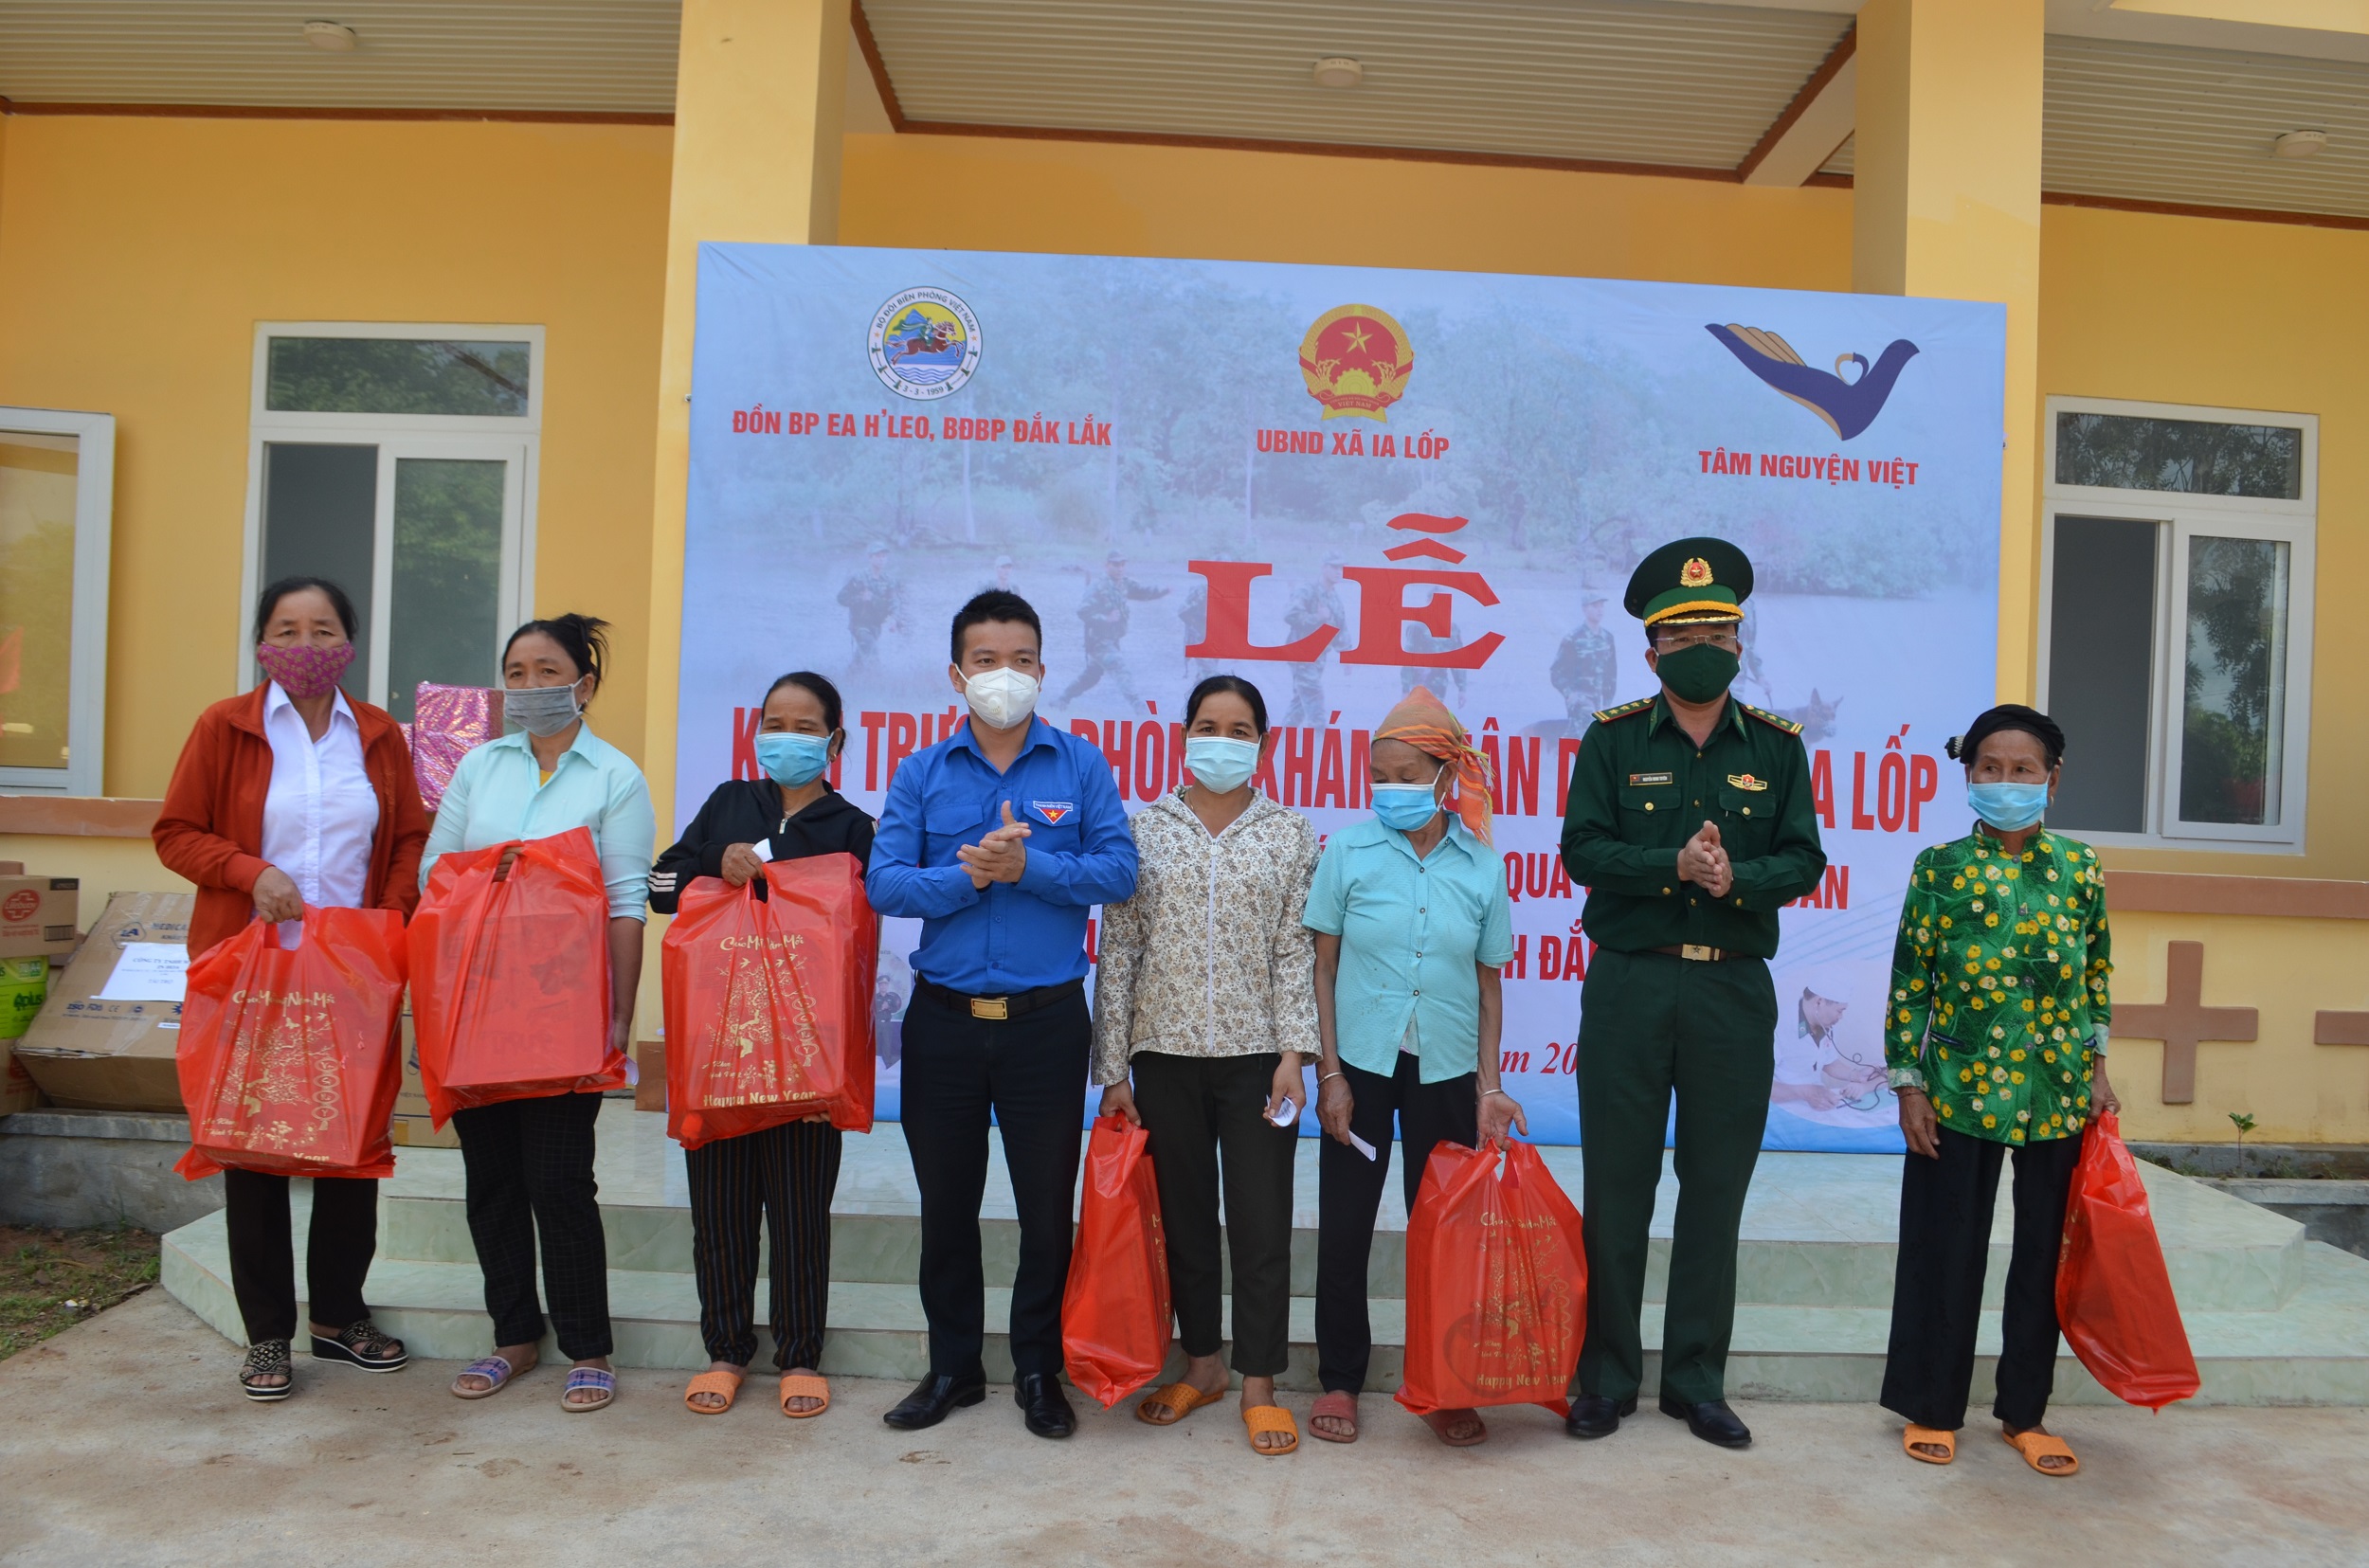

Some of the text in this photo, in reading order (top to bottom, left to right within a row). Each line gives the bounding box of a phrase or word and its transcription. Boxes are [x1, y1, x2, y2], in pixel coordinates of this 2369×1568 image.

[876, 290, 976, 333] BỘ ĐỘI BIÊN PHÒNG VIỆT NAM
[927, 386, 944, 396] 1959
[732, 404, 781, 435] ĐỒN
[788, 411, 820, 435] BP
[827, 413, 857, 437] EA
[943, 417, 1005, 442] BĐBP
[1013, 412, 1060, 443] ĐẮK
[1068, 413, 1112, 446] LẮK
[1257, 428, 1450, 460] UBND XÃ IA LỐP
[1698, 446, 1919, 490] TÂM NGUYỆN VIỆT
[1184, 513, 1506, 669] LỄ
[1852, 724, 1938, 834] LỐP
[152, 923, 188, 931] MEDICA
[1538, 919, 1599, 982] ĐẮ
[703, 1090, 817, 1108] Happy New Year
[1476, 1374, 1513, 1390] Happy
